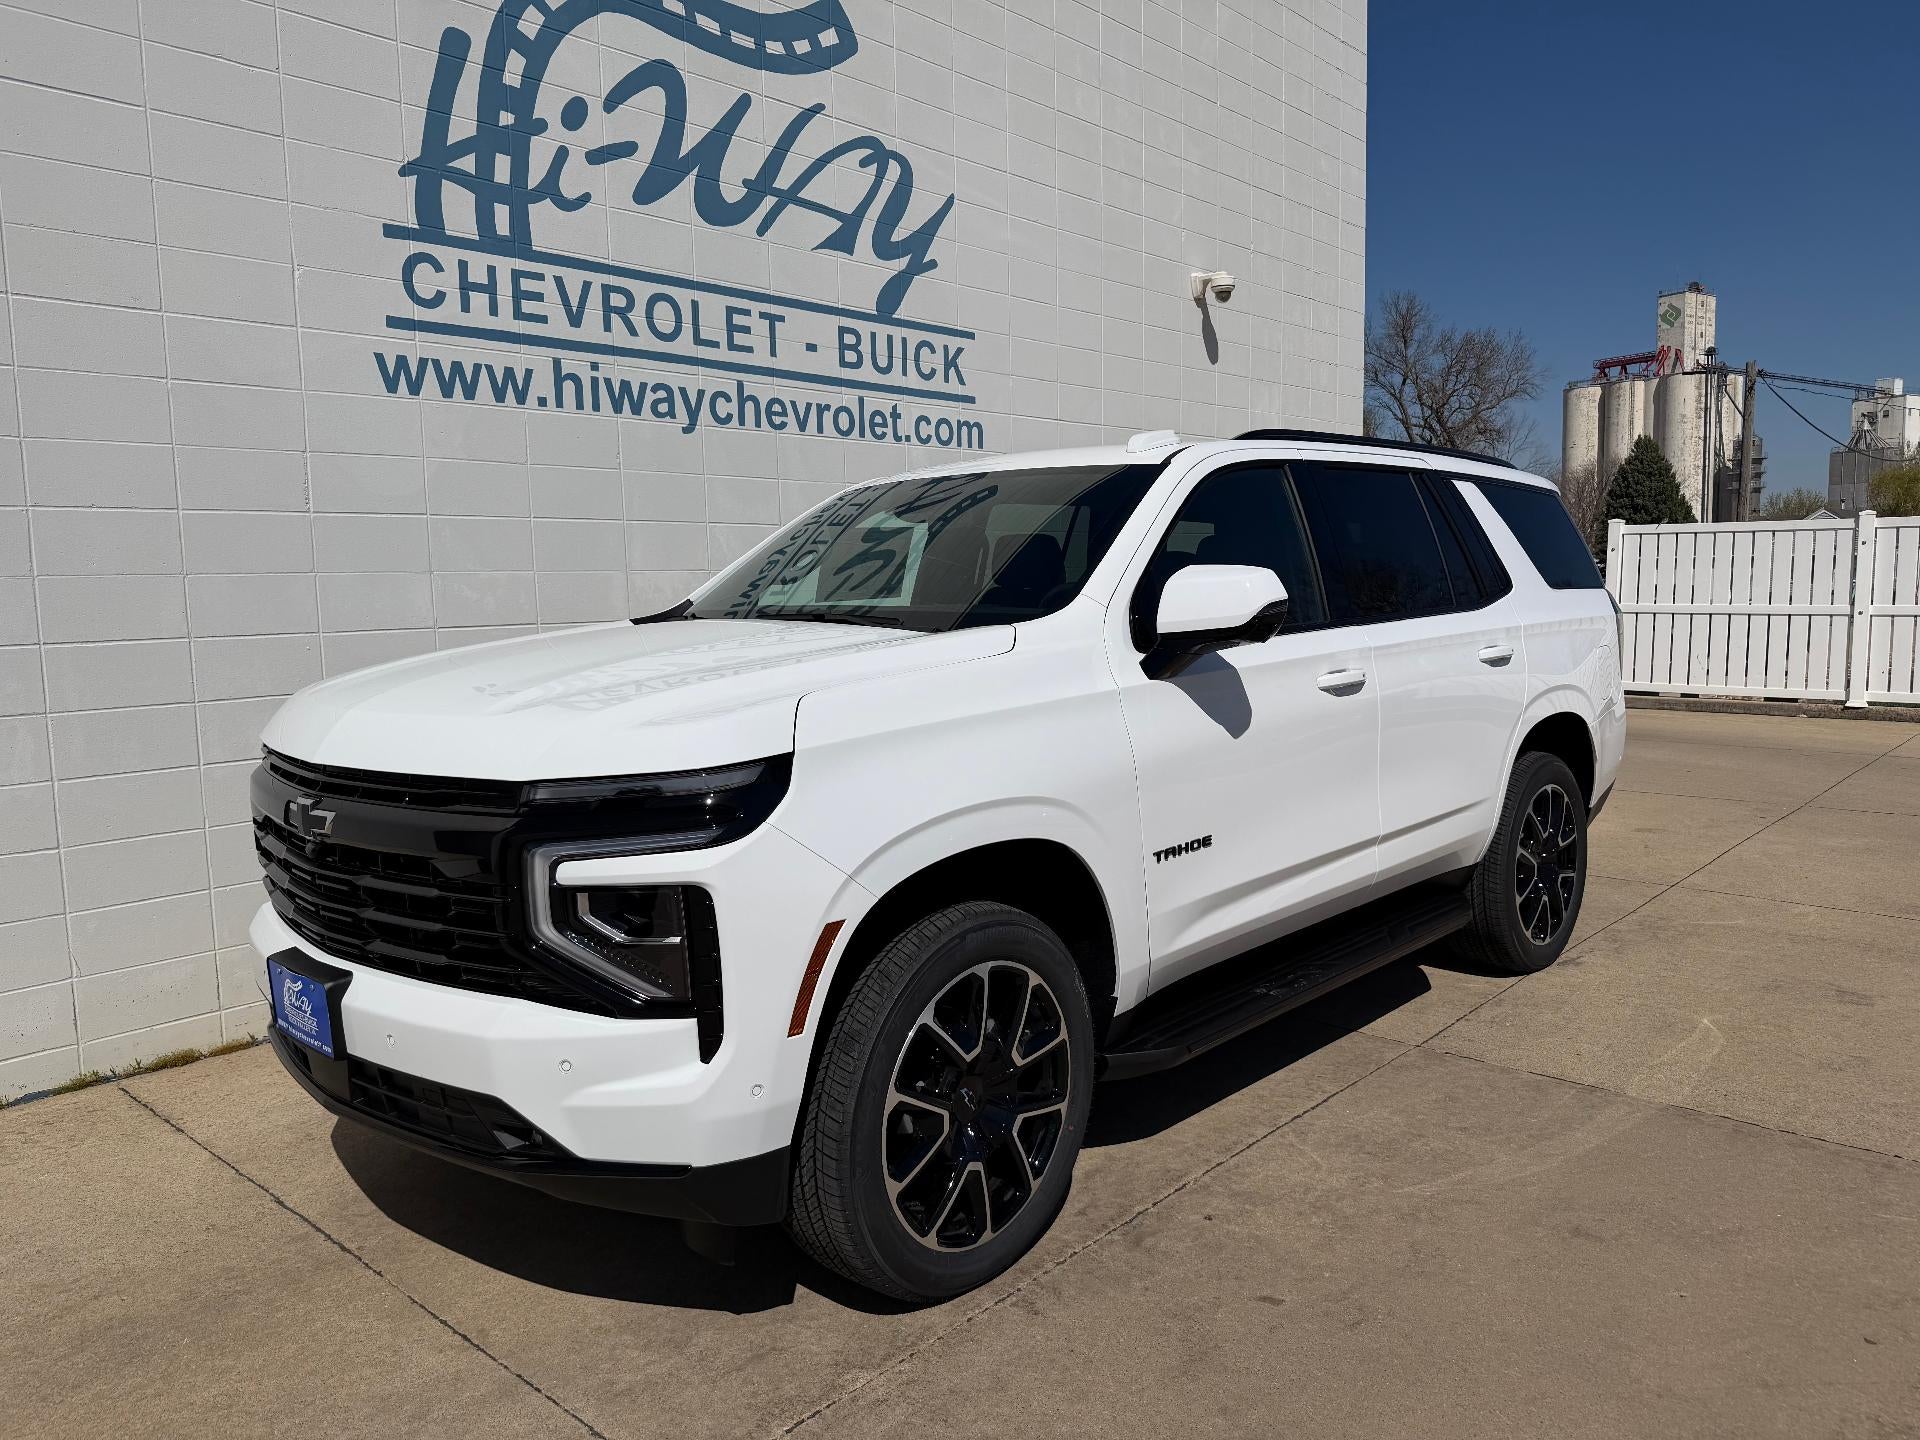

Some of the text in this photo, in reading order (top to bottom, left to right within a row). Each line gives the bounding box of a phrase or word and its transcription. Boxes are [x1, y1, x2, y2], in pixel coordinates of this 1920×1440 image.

[400, 252, 787, 359] CHEVROLET
[837, 325, 967, 387] BUICK
[373, 351, 985, 450] www.hiwaychevrolet.com
[1152, 834, 1213, 864] TAHOE
